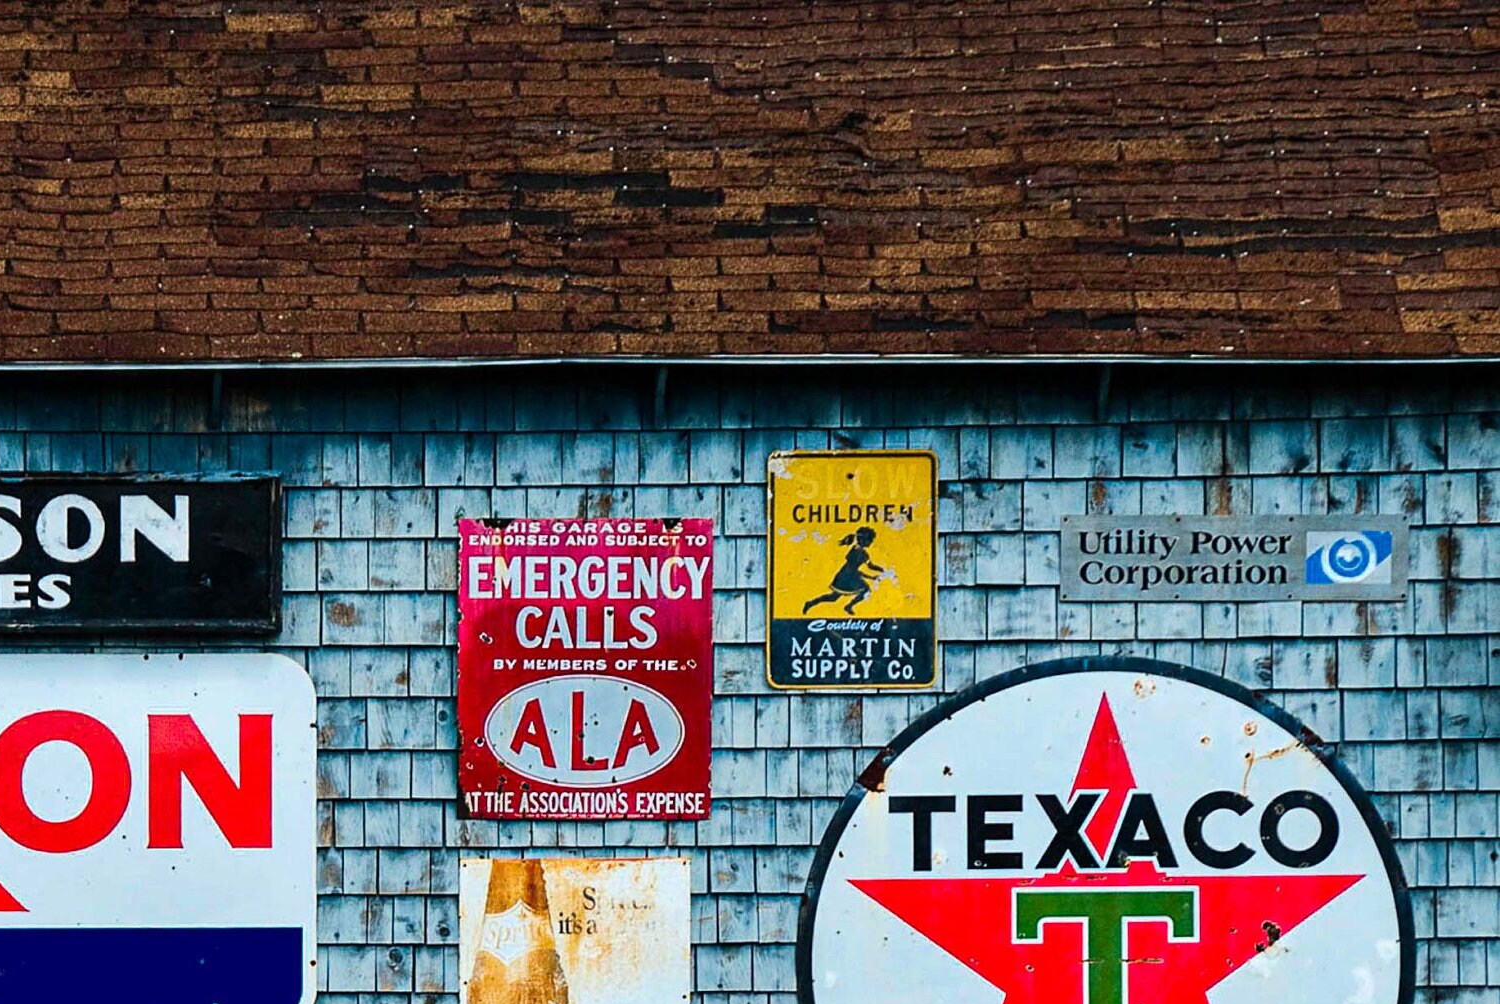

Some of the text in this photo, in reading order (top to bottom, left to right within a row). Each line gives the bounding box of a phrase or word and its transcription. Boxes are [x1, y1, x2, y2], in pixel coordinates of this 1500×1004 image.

[792, 504, 913, 523] CHILDREN
[552, 521, 646, 534] GARAGE
[468, 534, 707, 547] ENDORSED AND SUBJECT TO
[1078, 529, 1293, 560] Utility Power
[468, 556, 710, 600] EMERGENCY
[1079, 559, 1287, 591] Corporation
[515, 605, 658, 650] CALLS
[807, 618, 884, 633] Courtesy of
[790, 637, 917, 659] MARTIN
[493, 659, 678, 671] BY MEMBERS OF THE
[791, 660, 874, 680] SUPPLY
[510, 691, 660, 771] ALA
[466, 788, 706, 815] AT THE ASSOCIATION'S EXPENSE
[887, 789, 1340, 873] TEXACO
[558, 912, 599, 936] it's a
